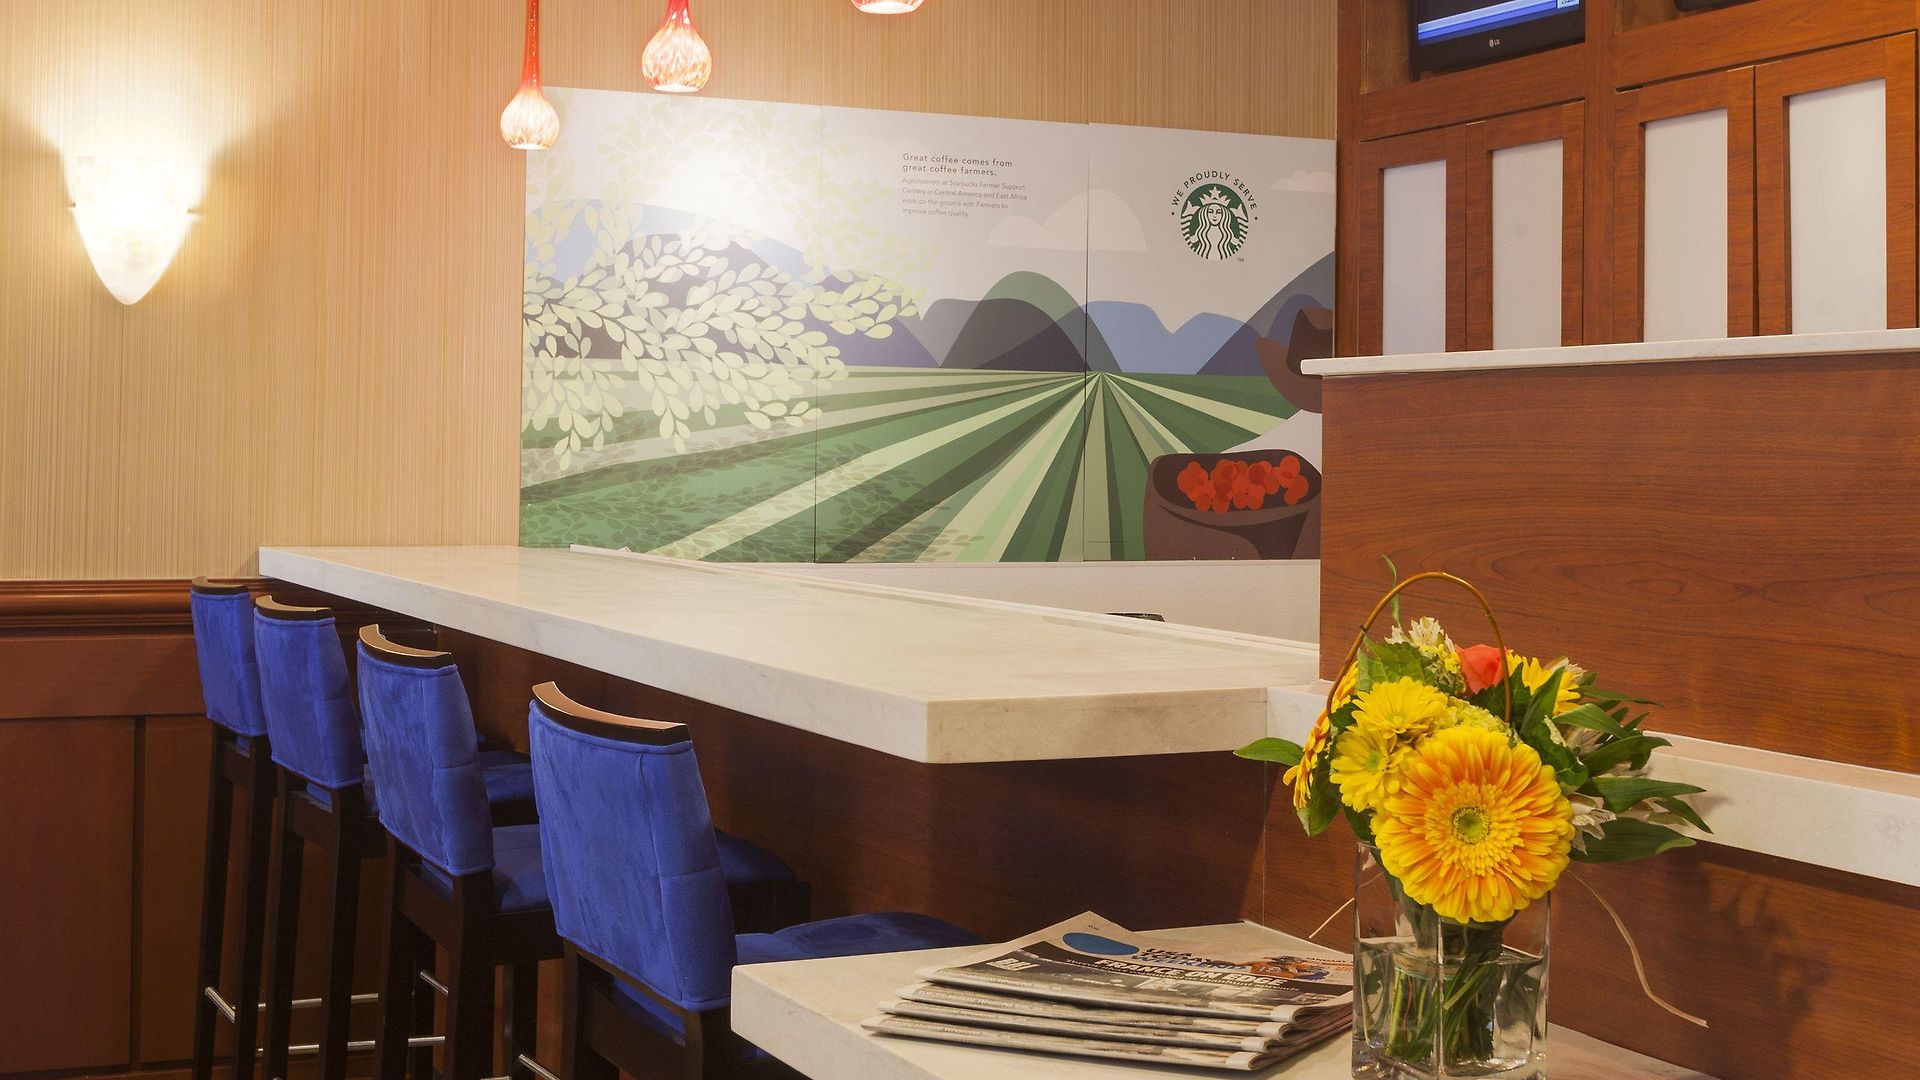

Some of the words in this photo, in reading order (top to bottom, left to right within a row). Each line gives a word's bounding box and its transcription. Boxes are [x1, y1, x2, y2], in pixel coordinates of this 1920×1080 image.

[903, 153, 928, 161] Great
[931, 155, 959, 164] coffee
[961, 158, 989, 166] comes
[992, 158, 1013, 167] from
[902, 164, 926, 173] great
[929, 166, 958, 174] coffee
[960, 167, 997, 176] farmers.
[902, 177, 940, 187] Agronomists
[949, 180, 978, 188] Starbucks
[1001, 182, 1026, 191] Support
[1171, 189, 1184, 206] WE
[1183, 170, 1231, 189] PROUDLY
[1233, 178, 1258, 210] SERVE
[902, 187, 926, 195] Centers
[934, 188, 957, 197] Central
[957, 190, 984, 198] America
[984, 191, 995, 199] and
[1009, 193, 1027, 201] Africa
[902, 197, 917, 205] work
[939, 200, 961, 208] ground
[976, 202, 1000, 210] Farmers
[902, 207, 927, 216] improve
[1094, 959, 1182, 977] FRANCE
[1184, 970, 1221, 981] ON
[1222, 972, 1288, 987] EDGE
